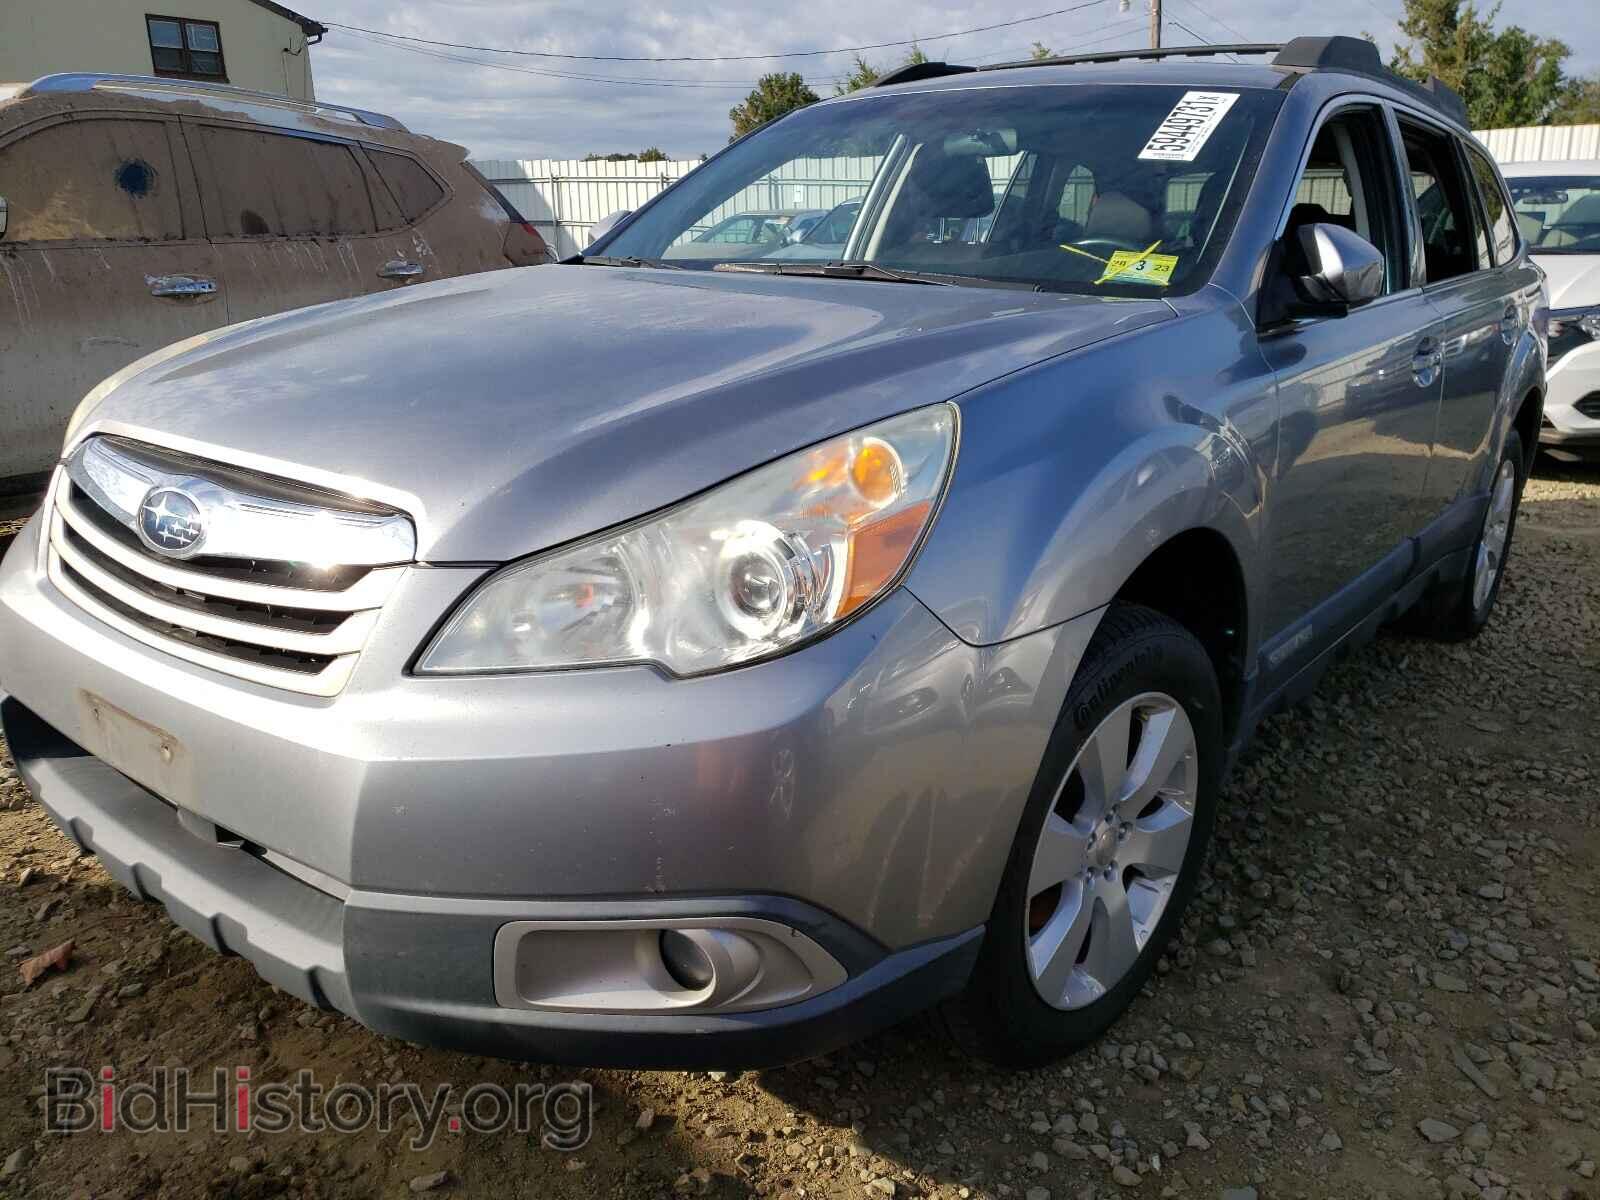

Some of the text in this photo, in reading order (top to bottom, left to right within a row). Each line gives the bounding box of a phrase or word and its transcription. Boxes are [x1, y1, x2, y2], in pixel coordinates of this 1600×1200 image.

[1146, 100, 1219, 152] 59449731
[1135, 259, 1147, 271] 3
[1153, 264, 1170, 273] 23
